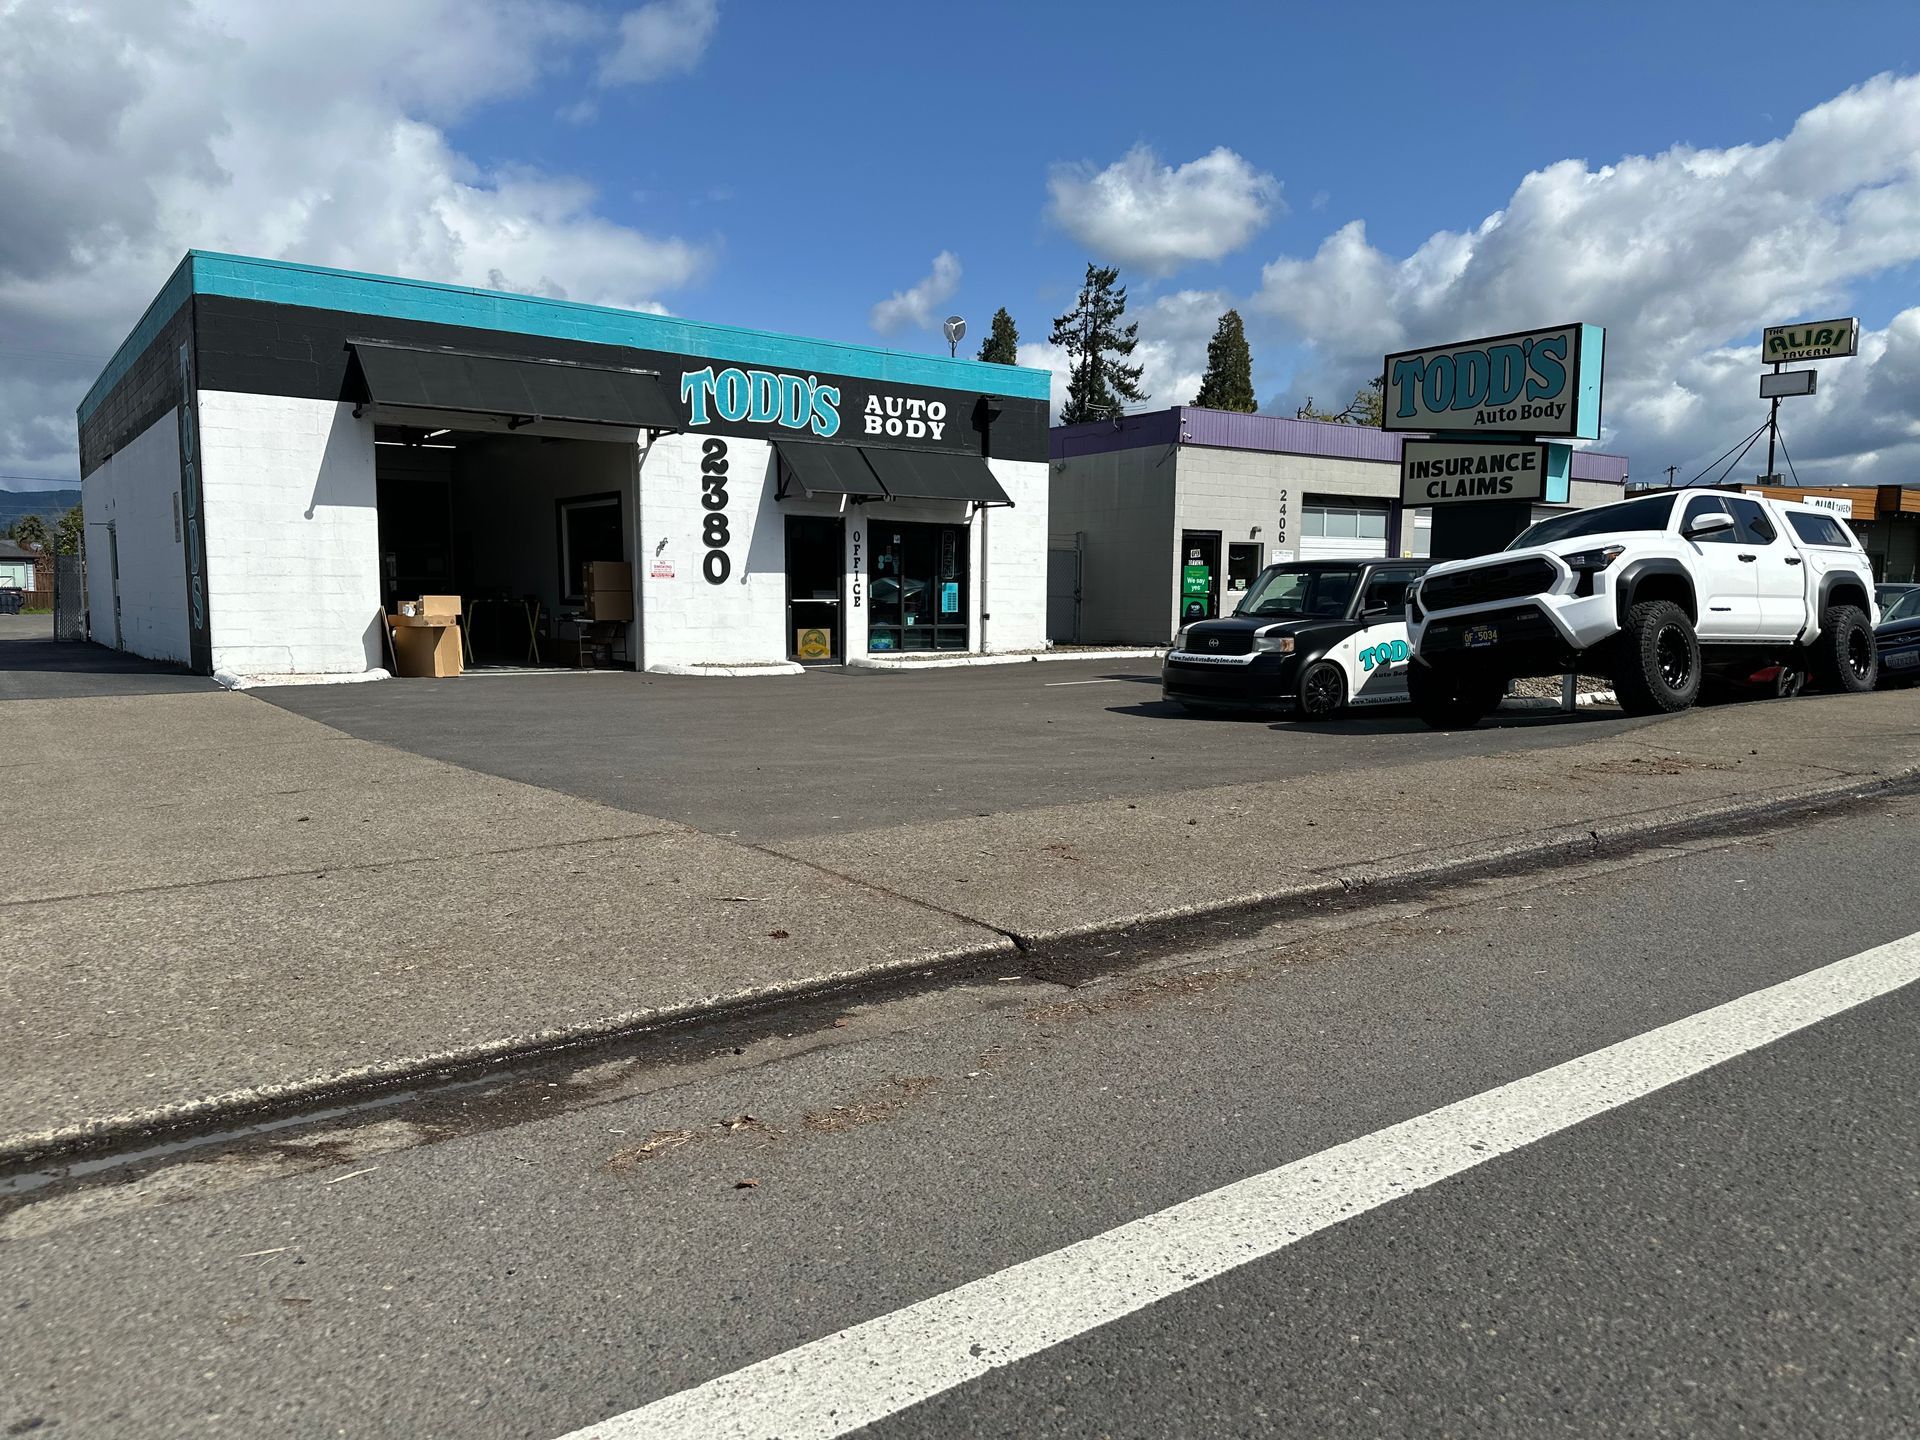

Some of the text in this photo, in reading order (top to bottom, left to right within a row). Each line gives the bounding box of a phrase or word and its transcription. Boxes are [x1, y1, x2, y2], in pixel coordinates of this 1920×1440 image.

[1769, 329, 1846, 353] ALIBI
[1782, 348, 1830, 359] TAVERN
[1392, 335, 1567, 418] TODD'S
[682, 366, 840, 437] TODD'S
[864, 394, 946, 420] AUTO
[1474, 402, 1567, 426] Auto Body
[863, 415, 946, 440] BODY
[1409, 452, 1536, 479] INSURANCE
[1426, 476, 1513, 498] CLAIMS
[700, 437, 731, 585] 2380
[1279, 489, 1288, 544] 2406
[853, 531, 861, 607] OFFICE
[1196, 578, 1206, 586] say
